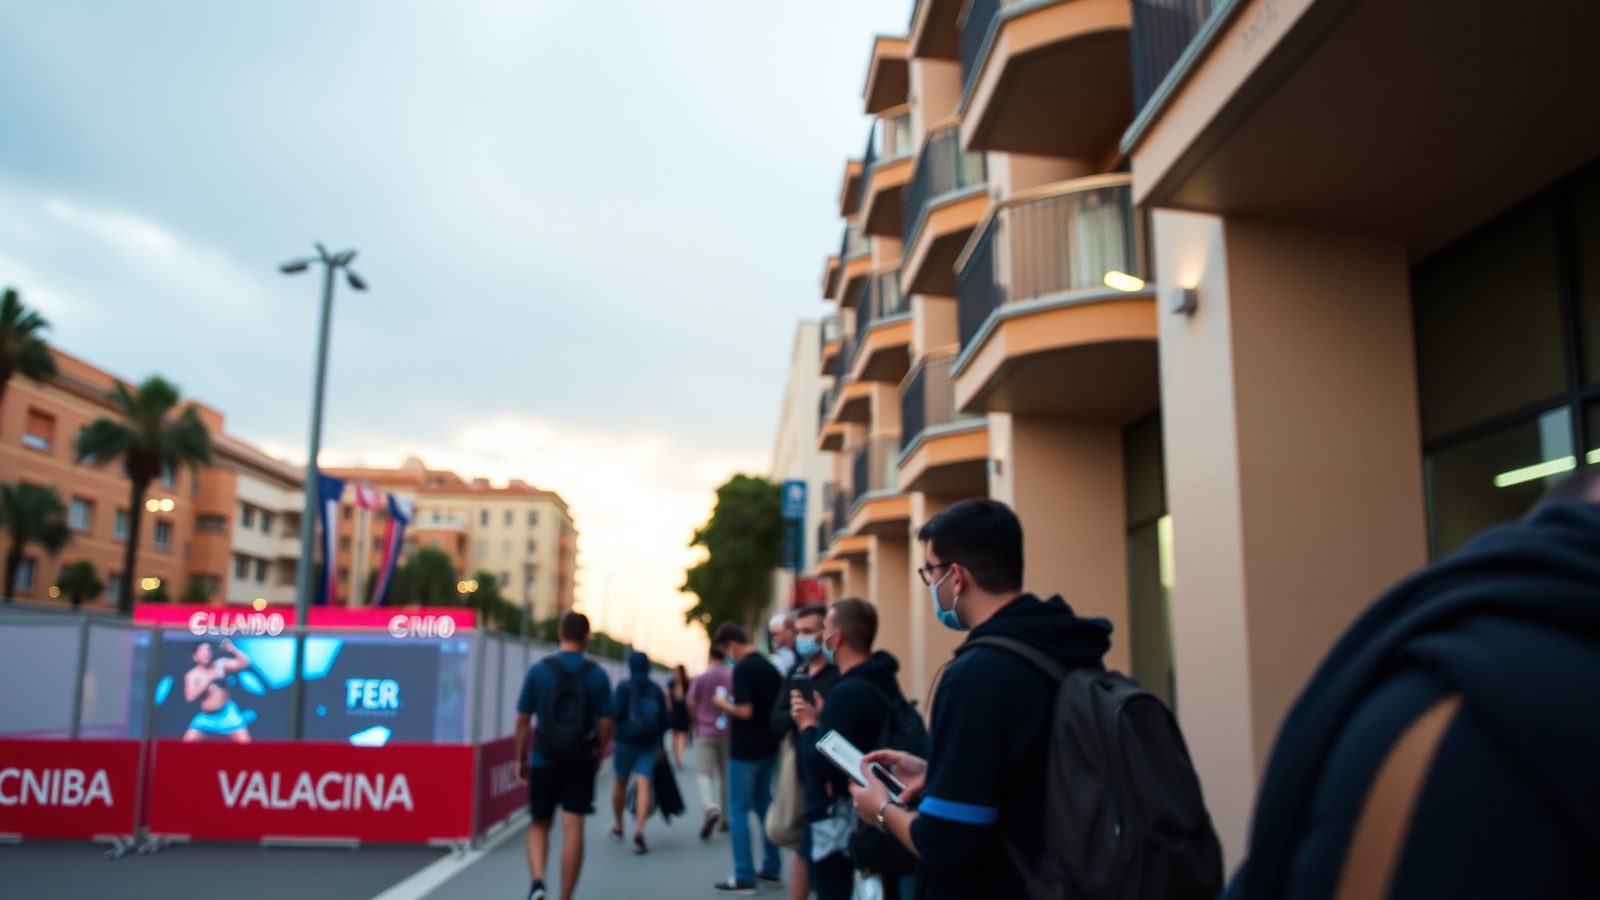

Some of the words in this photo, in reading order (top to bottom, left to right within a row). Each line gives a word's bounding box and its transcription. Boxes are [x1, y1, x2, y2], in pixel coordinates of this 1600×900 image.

[345, 678, 400, 709] FER
[0, 767, 114, 807] CNIBA
[217, 770, 415, 812] VALACINA
